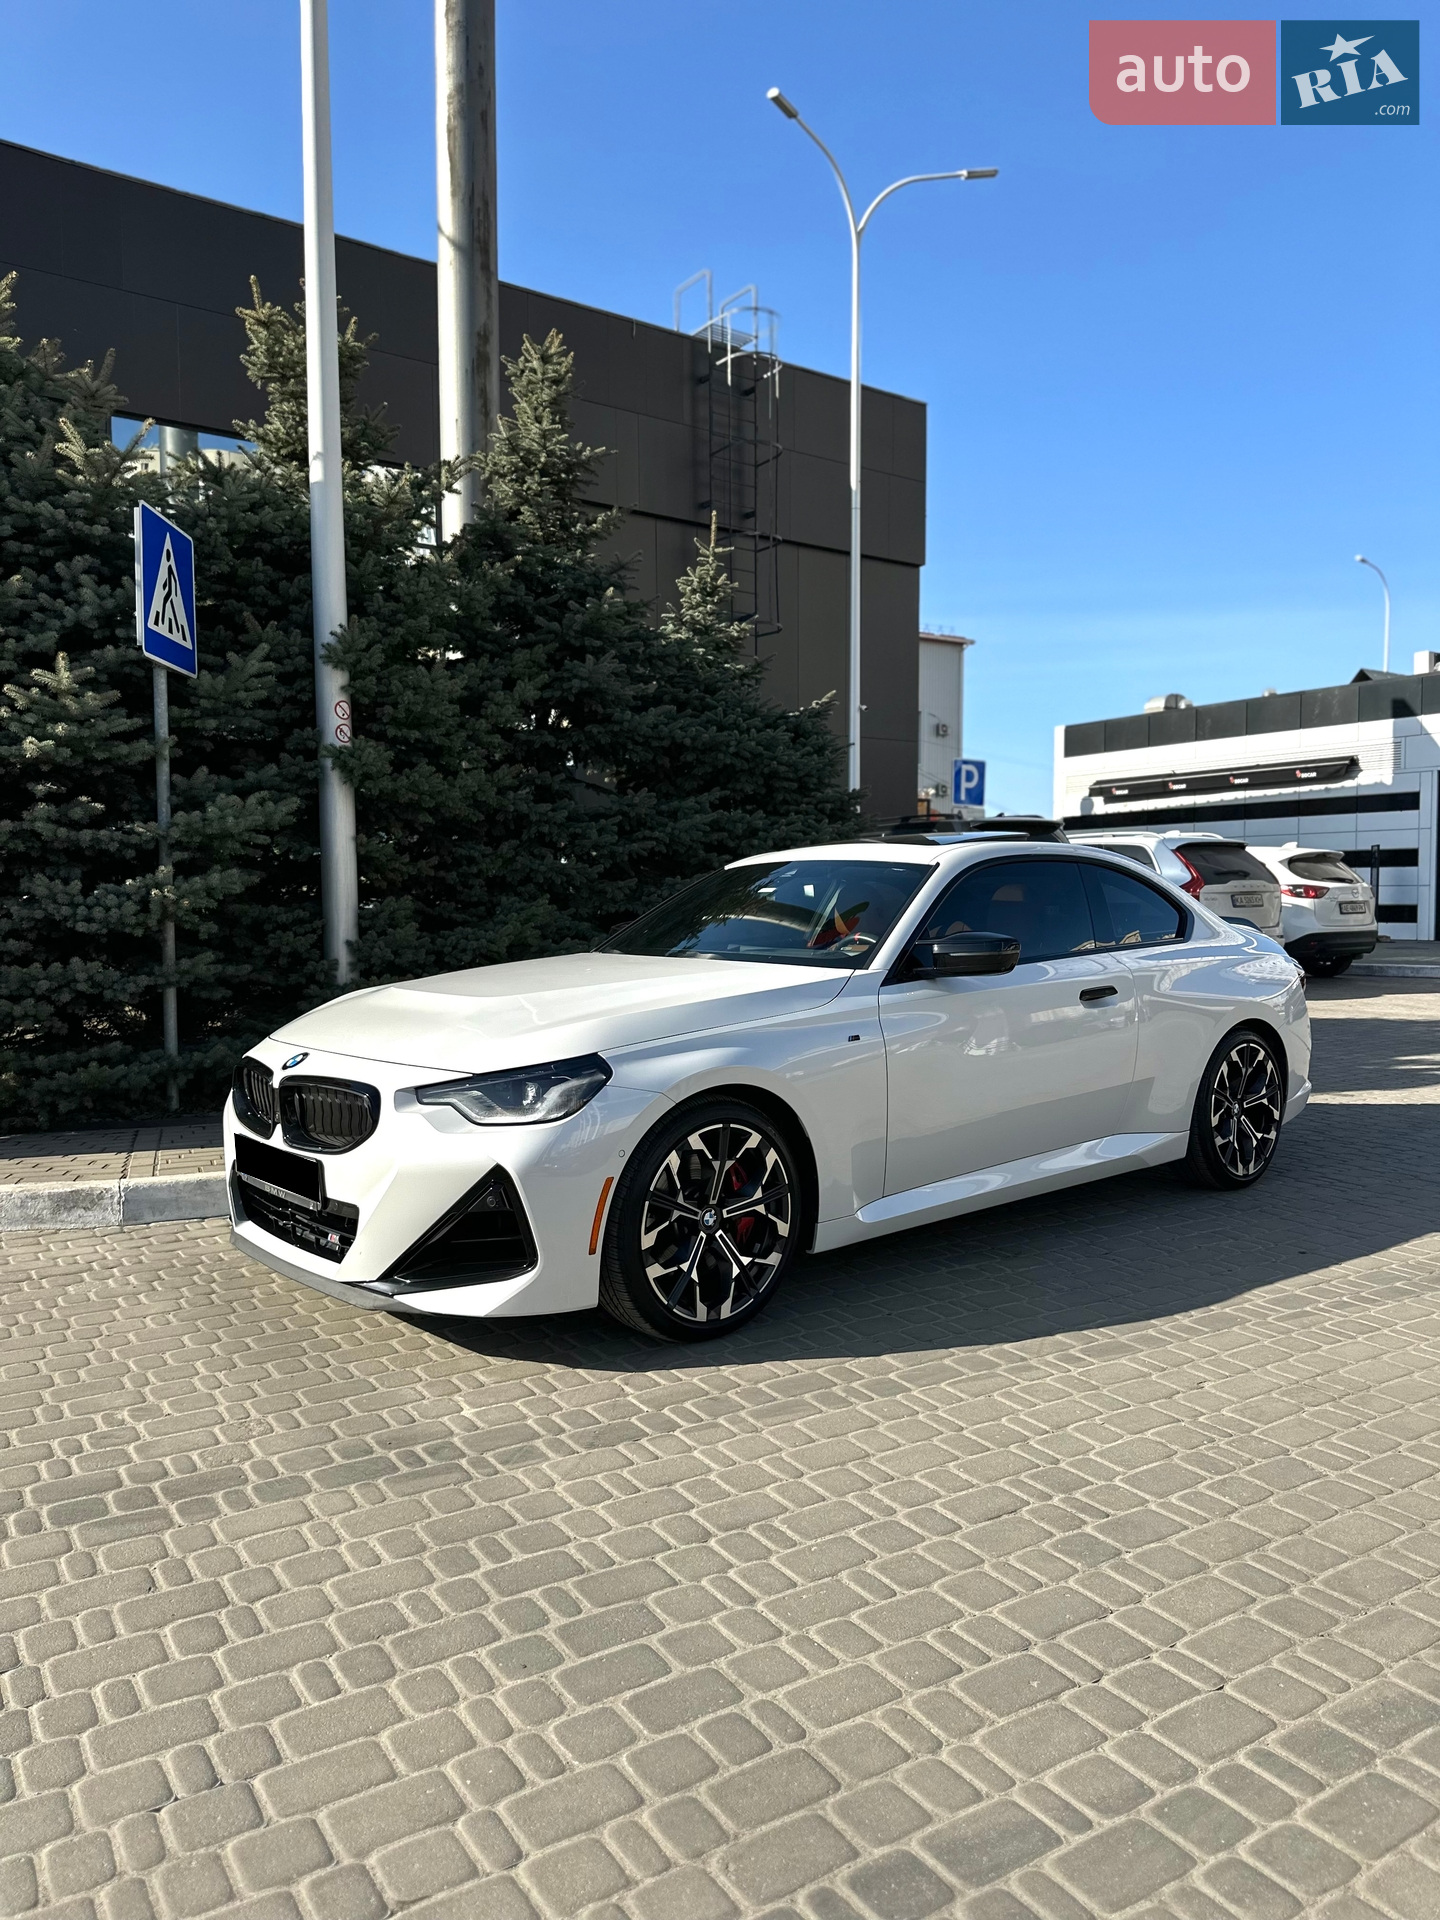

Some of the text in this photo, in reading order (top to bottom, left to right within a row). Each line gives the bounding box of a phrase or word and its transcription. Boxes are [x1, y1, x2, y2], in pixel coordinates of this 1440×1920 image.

[961, 764, 979, 800] P
[1300, 771, 1317, 779] SOCAR
[264, 1184, 286, 1198] BMW
